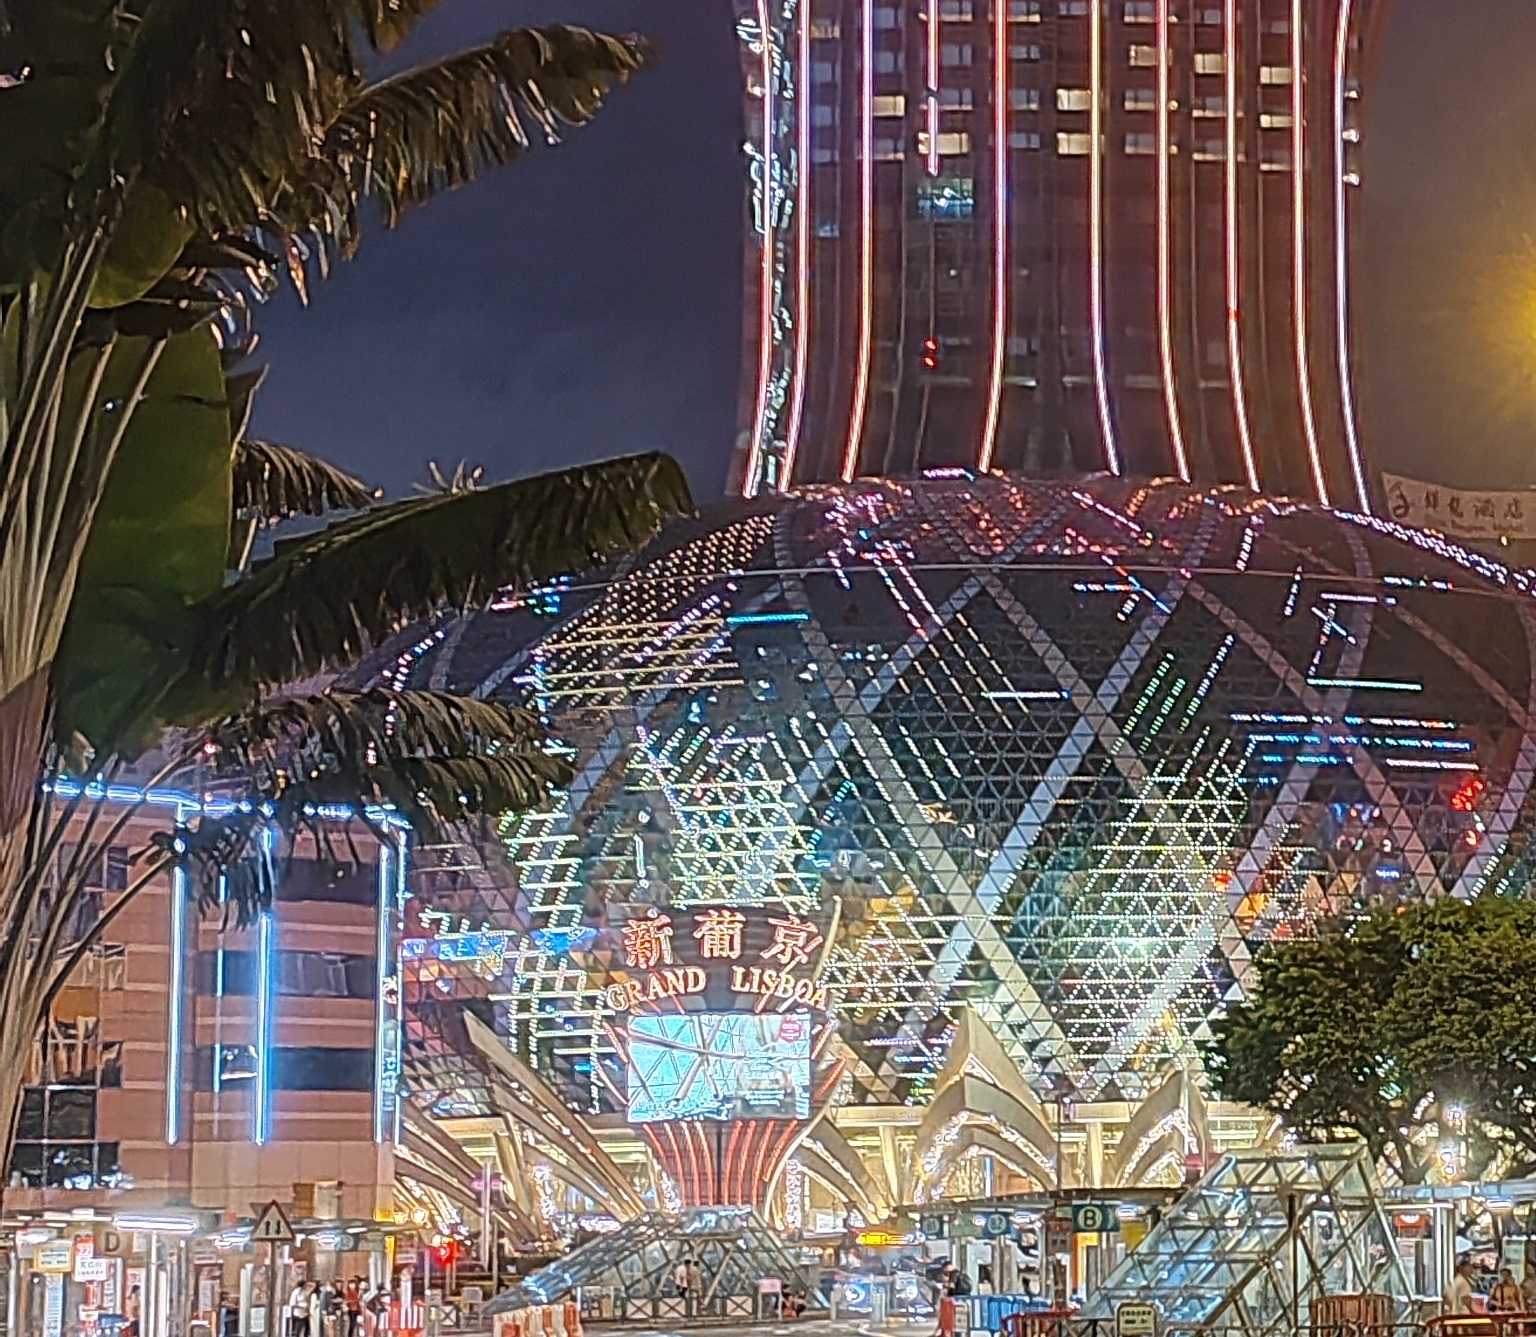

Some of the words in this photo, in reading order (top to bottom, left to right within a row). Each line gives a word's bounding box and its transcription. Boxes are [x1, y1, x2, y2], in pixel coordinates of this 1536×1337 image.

[621, 909, 823, 969] 新葡京
[606, 966, 707, 1012] GRAND
[730, 964, 827, 1011] LISBOA
[1083, 1208, 1098, 1228] B
[105, 1231, 121, 1252] D
